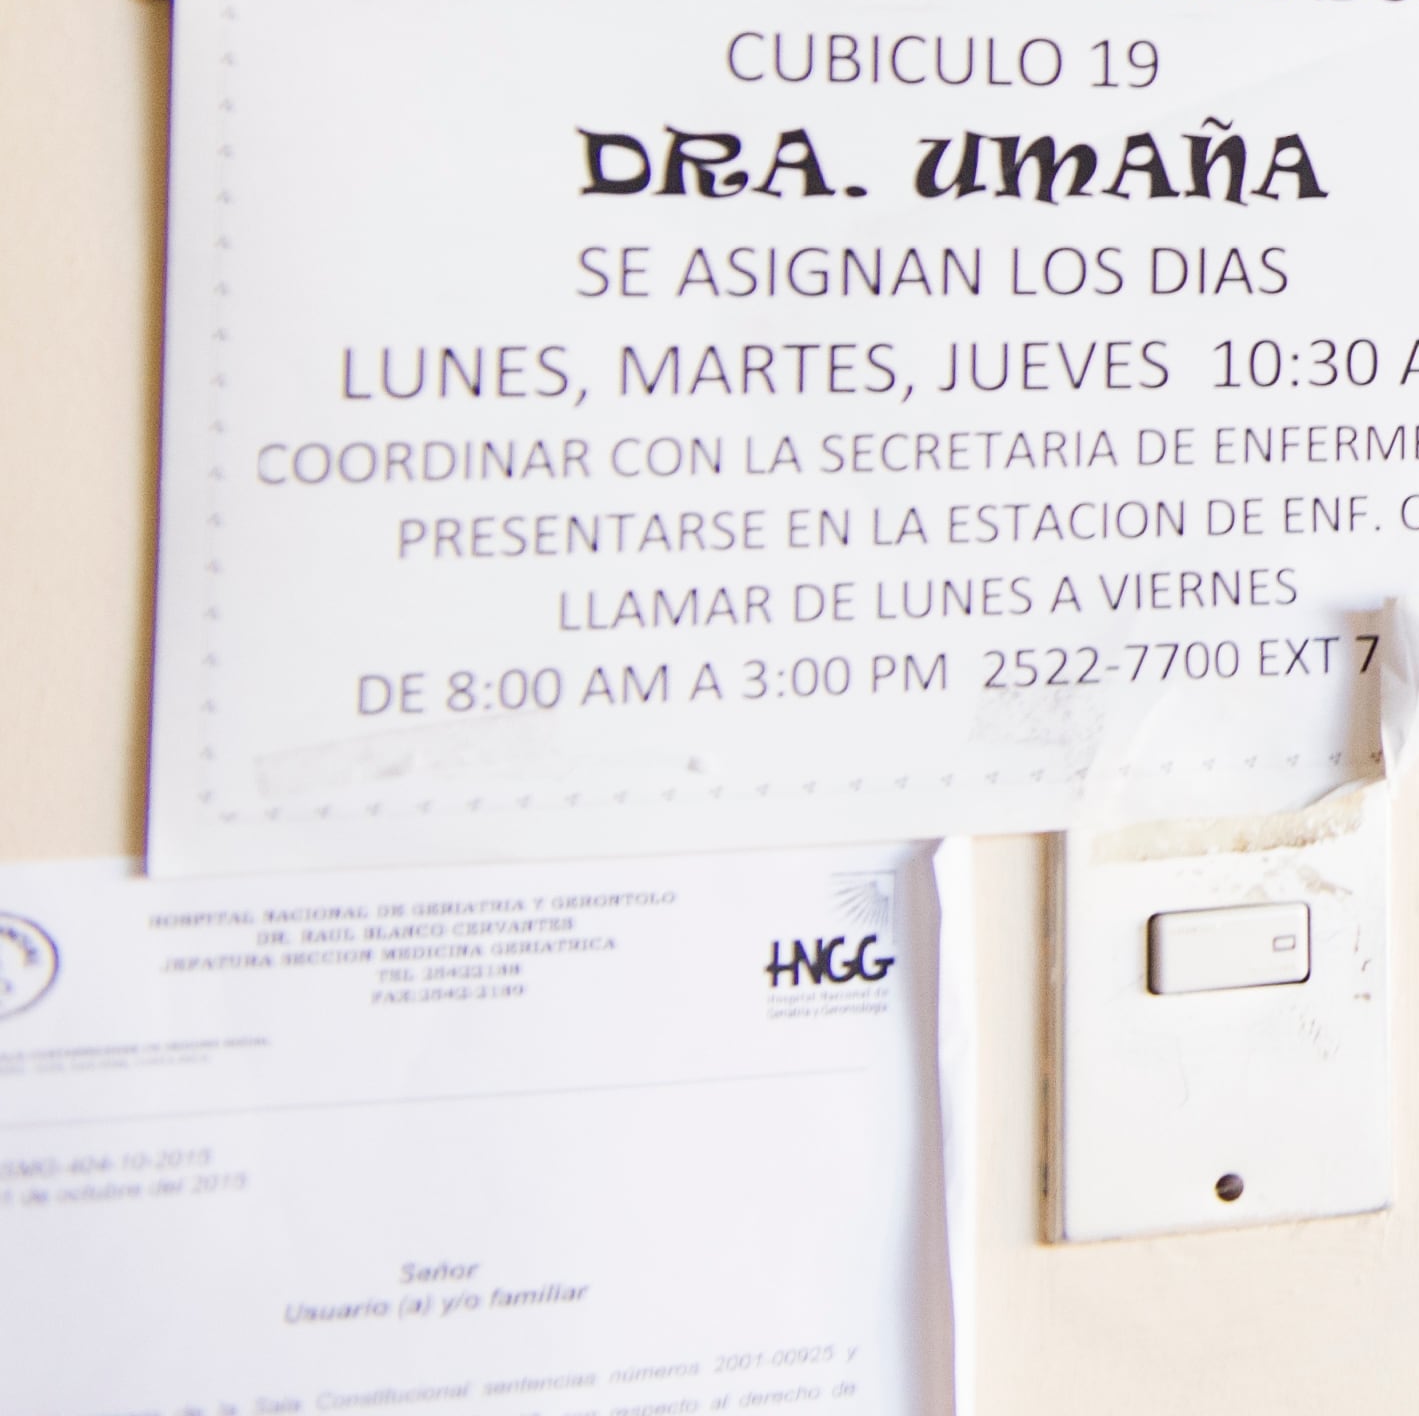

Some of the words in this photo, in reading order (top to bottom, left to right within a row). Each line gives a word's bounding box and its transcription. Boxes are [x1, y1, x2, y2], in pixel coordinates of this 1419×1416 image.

[726, 31, 1063, 88] CUBICULO
[1092, 39, 1159, 89] 19
[577, 125, 868, 199] DRA.
[577, 245, 650, 298] SE
[676, 246, 981, 298] ASIGNAN
[1012, 246, 1124, 297] LOS
[1151, 246, 1288, 295] DIAS
[342, 344, 588, 407] LUNES,
[620, 342, 914, 403] MARTES,
[938, 339, 1170, 393] JUEVES
[1214, 338, 1379, 388] 10:30
[256, 437, 591, 487] COORDINAR
[610, 436, 723, 479] CON
[745, 434, 803, 475] LA
[821, 429, 1119, 474] SECRETARIA
[1137, 427, 1195, 467] DE
[398, 509, 766, 560] PRESENTARSE
[788, 508, 850, 549] EN
[872, 506, 929, 547] LA
[948, 500, 1185, 544] ESTACION
[1207, 497, 1264, 537] DE
[1283, 495, 1381, 534] ENF.
[559, 584, 772, 632] LLAMAR
[793, 581, 855, 624] DE
[876, 575, 1033, 620] LUNES
[1049, 575, 1082, 614] A
[1098, 567, 1298, 612] VIERNES
[356, 671, 425, 717] DE
[445, 666, 564, 713] 8:00
[580, 663, 669, 706] AM
[689, 661, 724, 701] A
[743, 655, 852, 700] 3:00
[871, 652, 947, 694] PM
[983, 640, 1240, 690] 2522-7700
[1259, 635, 1341, 678] EXT
[1355, 634, 1380, 674] 7
[149, 910, 255, 929] HOSPITAL
[263, 903, 368, 923] NACIONAL
[376, 901, 406, 918] DE
[412, 897, 525, 917] GERIATRIA
[531, 895, 546, 910] Y
[551, 892, 677, 911] GERONTOLO
[256, 929, 290, 947] DR.
[301, 925, 357, 943] RAUL
[363, 920, 446, 941] BLANCO
[452, 917, 575, 937] CERVANTES
[766, 935, 895, 986] HNGG
[398, 1258, 480, 1286] Señor
[283, 1296, 391, 1325] Usuario
[397, 1295, 433, 1320] (a)
[439, 1289, 482, 1317] y/o
[489, 1280, 590, 1311] familiar
